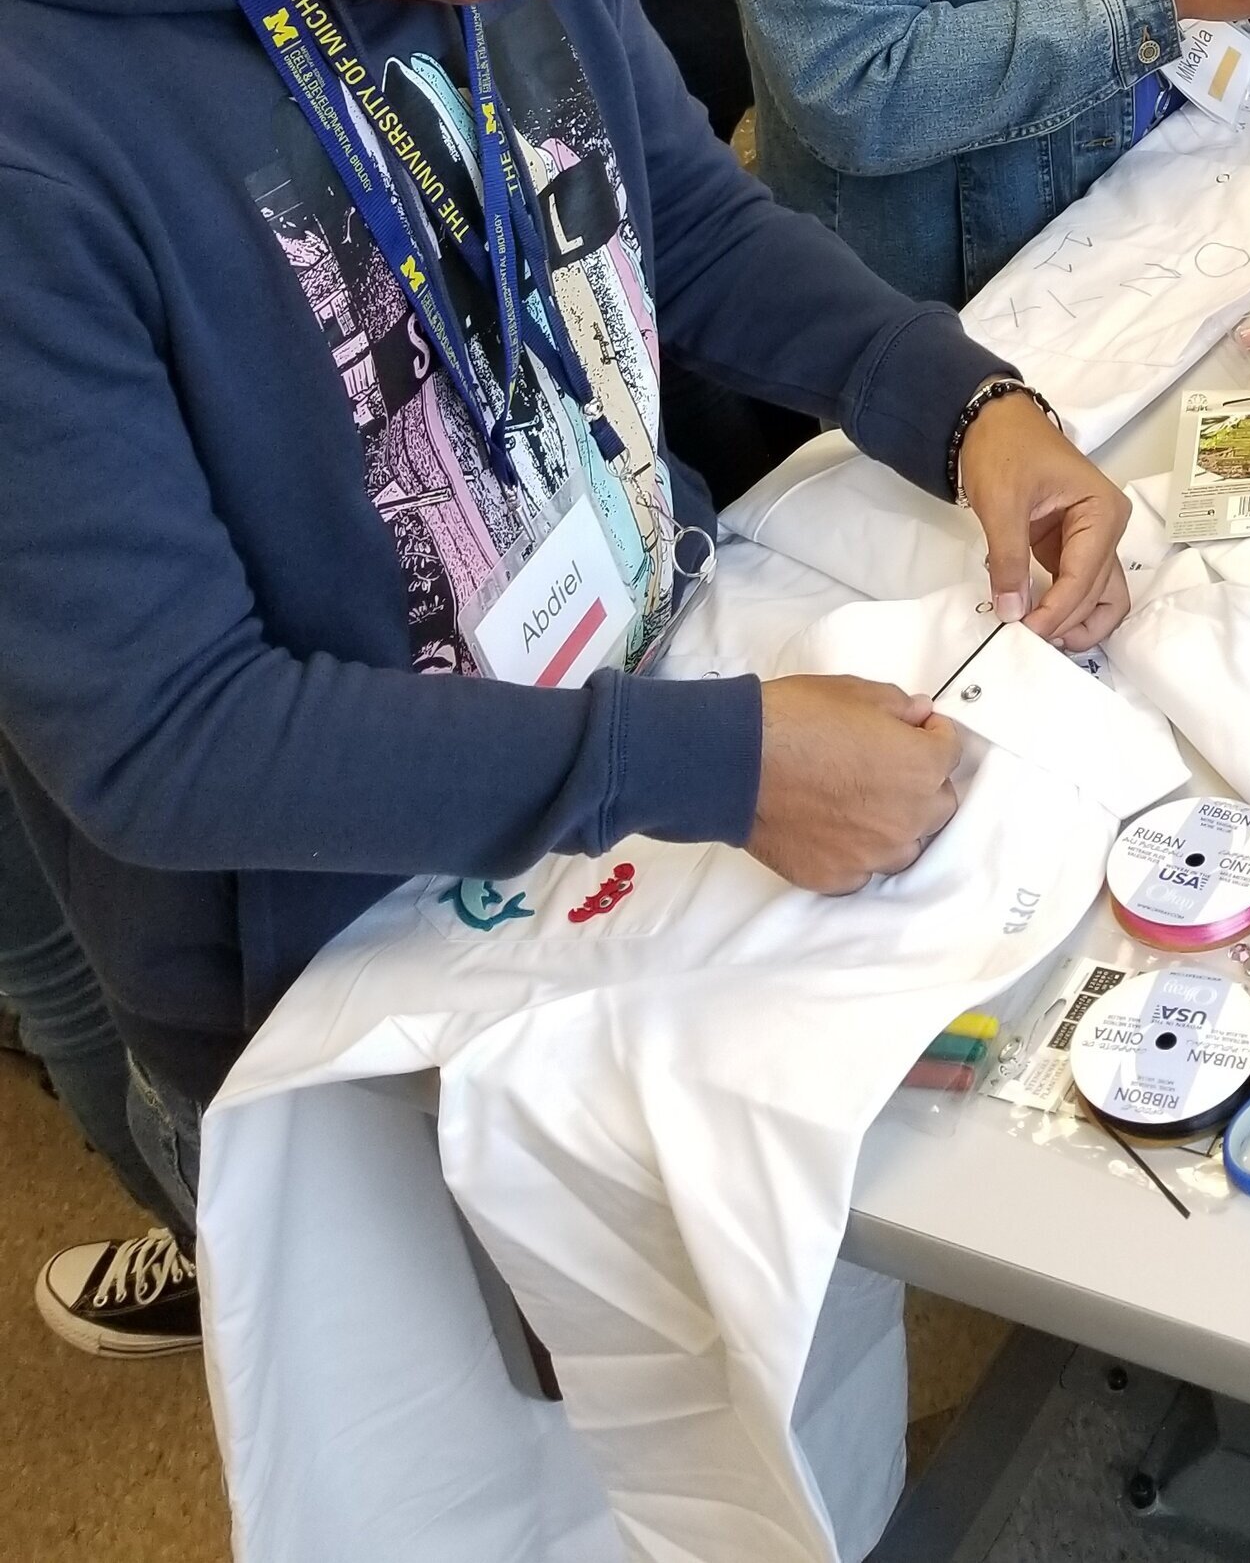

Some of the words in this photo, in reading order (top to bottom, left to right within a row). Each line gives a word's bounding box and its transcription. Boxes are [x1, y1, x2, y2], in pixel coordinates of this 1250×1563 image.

[289, 48, 305, 74] CELL
[335, 53, 367, 86] OF
[1175, 29, 1214, 84] Mikayla
[302, 71, 313, 82] &
[307, 80, 352, 159] DEVELOPMENTAL
[357, 84, 445, 204] UNIVERSITY
[349, 153, 374, 194] BIOLOGY
[501, 149, 518, 197] THE
[438, 196, 471, 245] THE
[495, 213, 507, 254] BIOLOGY
[522, 559, 583, 654] Abdiel
[1133, 826, 1186, 850] RUBAN
[1158, 867, 1202, 890] USA
[1161, 1005, 1208, 1025] USA
[1175, 1021, 1203, 1031] WOVEN
[1094, 1026, 1145, 1046] CINTA
[1186, 1049, 1248, 1070] RUBAN
[1114, 1086, 1180, 1110] RIBBON
